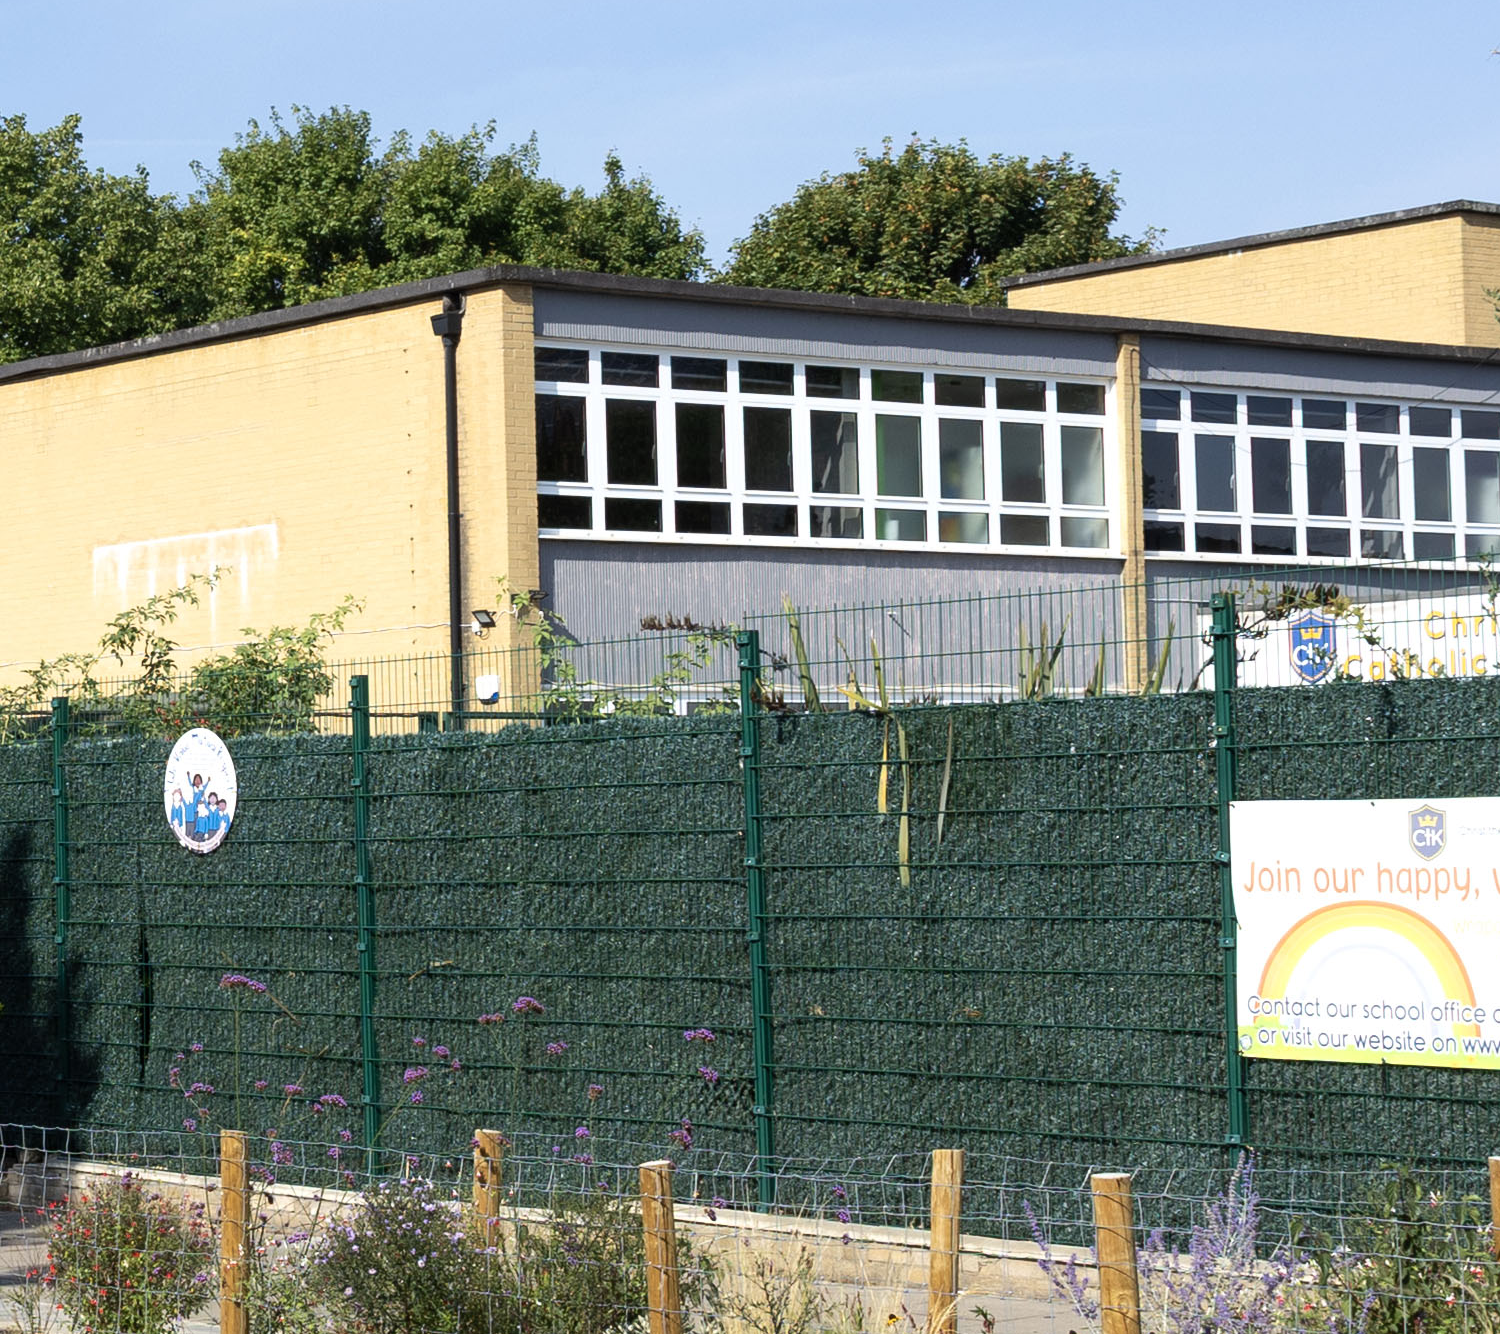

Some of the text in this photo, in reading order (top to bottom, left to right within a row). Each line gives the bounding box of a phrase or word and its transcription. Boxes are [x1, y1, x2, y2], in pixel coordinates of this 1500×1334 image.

[1412, 826, 1444, 847] CtK
[1243, 859, 1301, 893] Join
[1313, 866, 1364, 893] our
[1377, 861, 1480, 901] happy,
[1247, 995, 1321, 1017] Contact
[1326, 1001, 1357, 1019] our
[1362, 1000, 1425, 1021] school
[1431, 1001, 1486, 1024] office
[1258, 1029, 1277, 1045] or
[1282, 1026, 1312, 1046] visit
[1318, 1031, 1349, 1048] our
[1354, 1030, 1426, 1052] website
[1432, 1035, 1457, 1053] on
